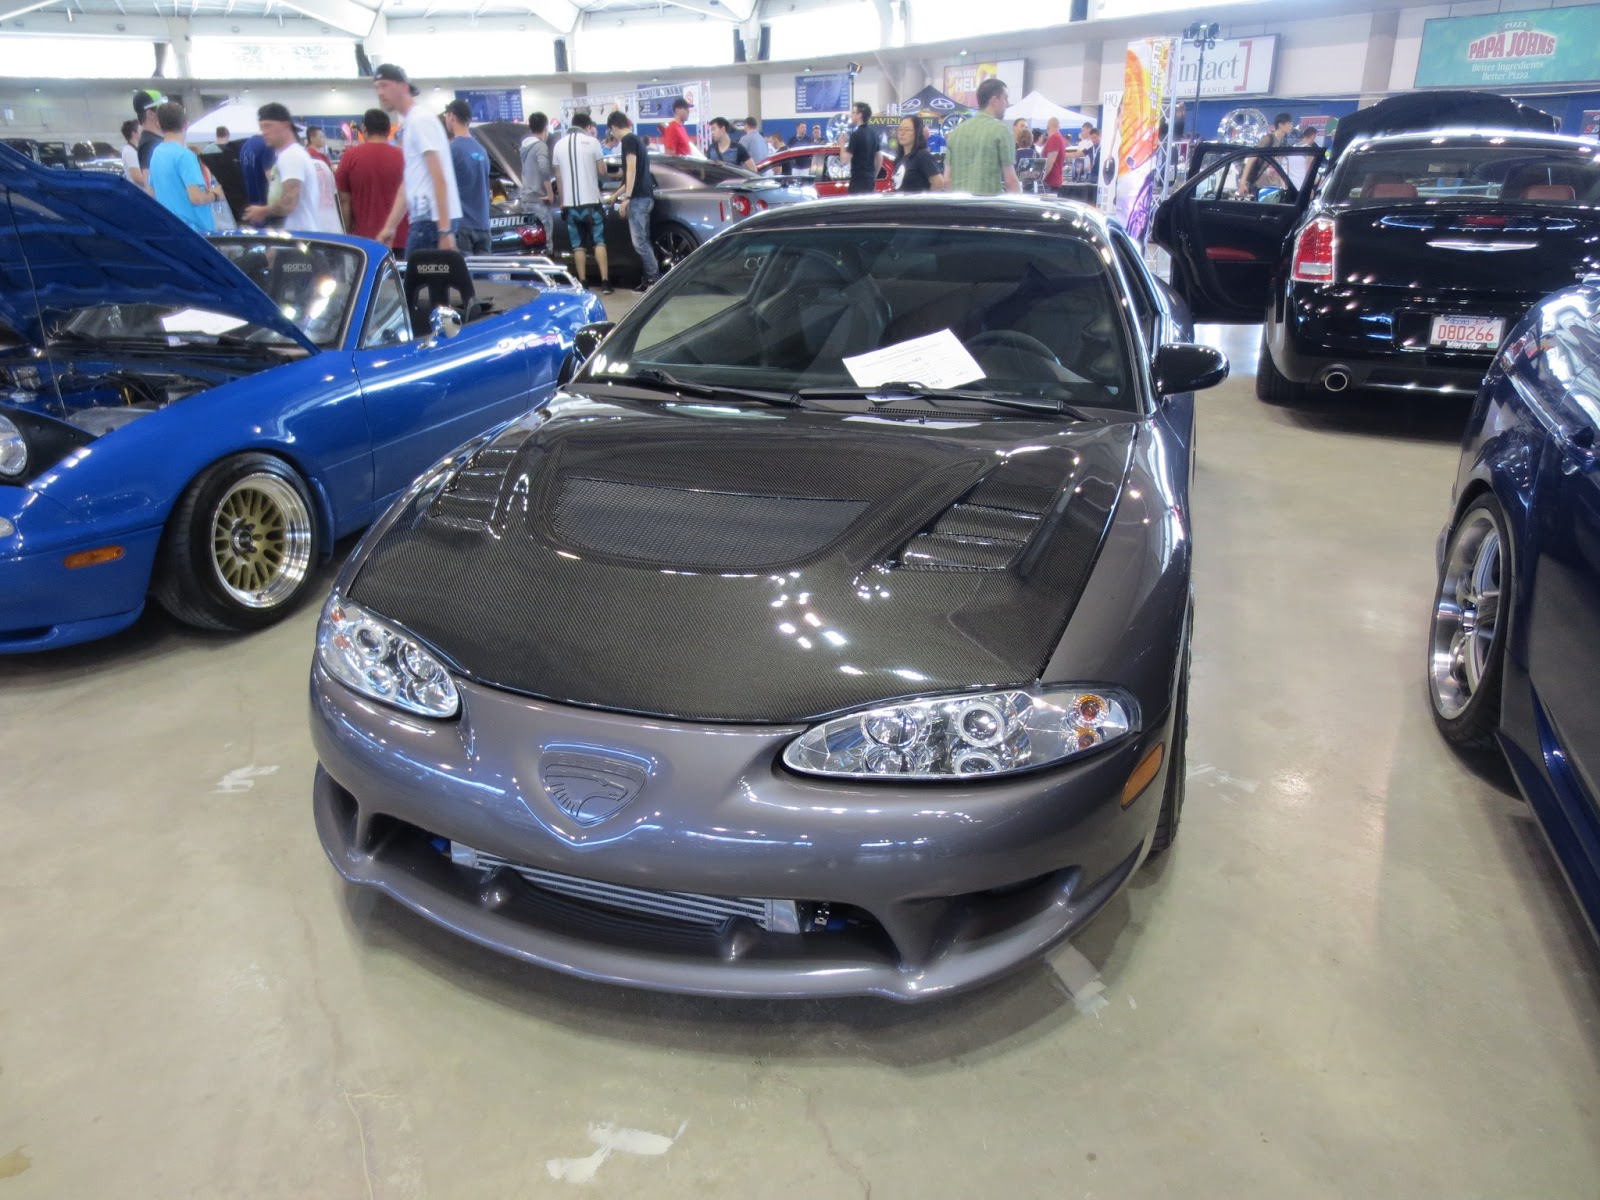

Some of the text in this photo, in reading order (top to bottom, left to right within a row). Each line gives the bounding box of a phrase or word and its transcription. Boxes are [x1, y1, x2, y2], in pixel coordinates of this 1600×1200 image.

[1504, 20, 1527, 29] PIZZA
[1468, 34, 1506, 59] PAPA
[1471, 63, 1495, 73] Better
[1481, 71, 1507, 81] Better
[416, 264, 450, 274] sparco
